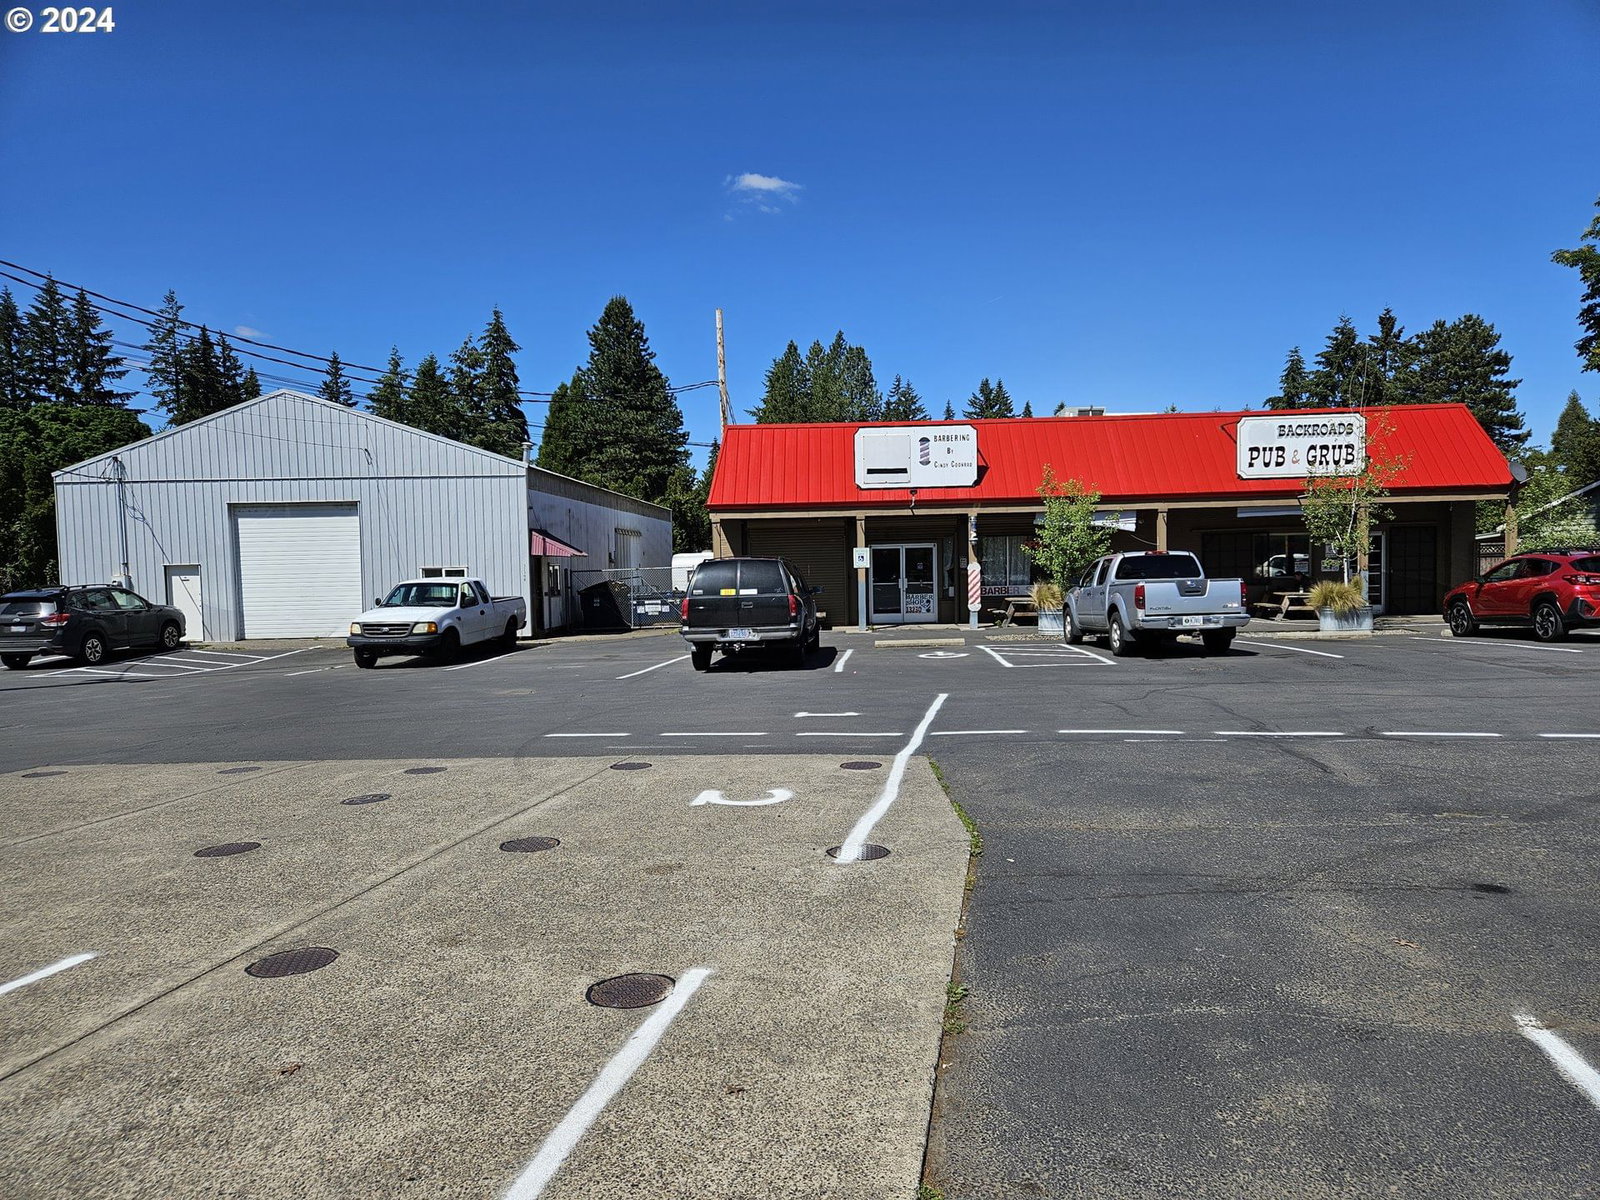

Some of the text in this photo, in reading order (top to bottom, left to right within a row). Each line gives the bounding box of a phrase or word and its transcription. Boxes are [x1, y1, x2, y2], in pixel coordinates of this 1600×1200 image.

[1278, 423, 1354, 437] BACKROADS
[933, 434, 970, 442] BARBERING
[1248, 443, 1355, 468] PUB & GRUB
[980, 586, 1020, 596] BARBER
